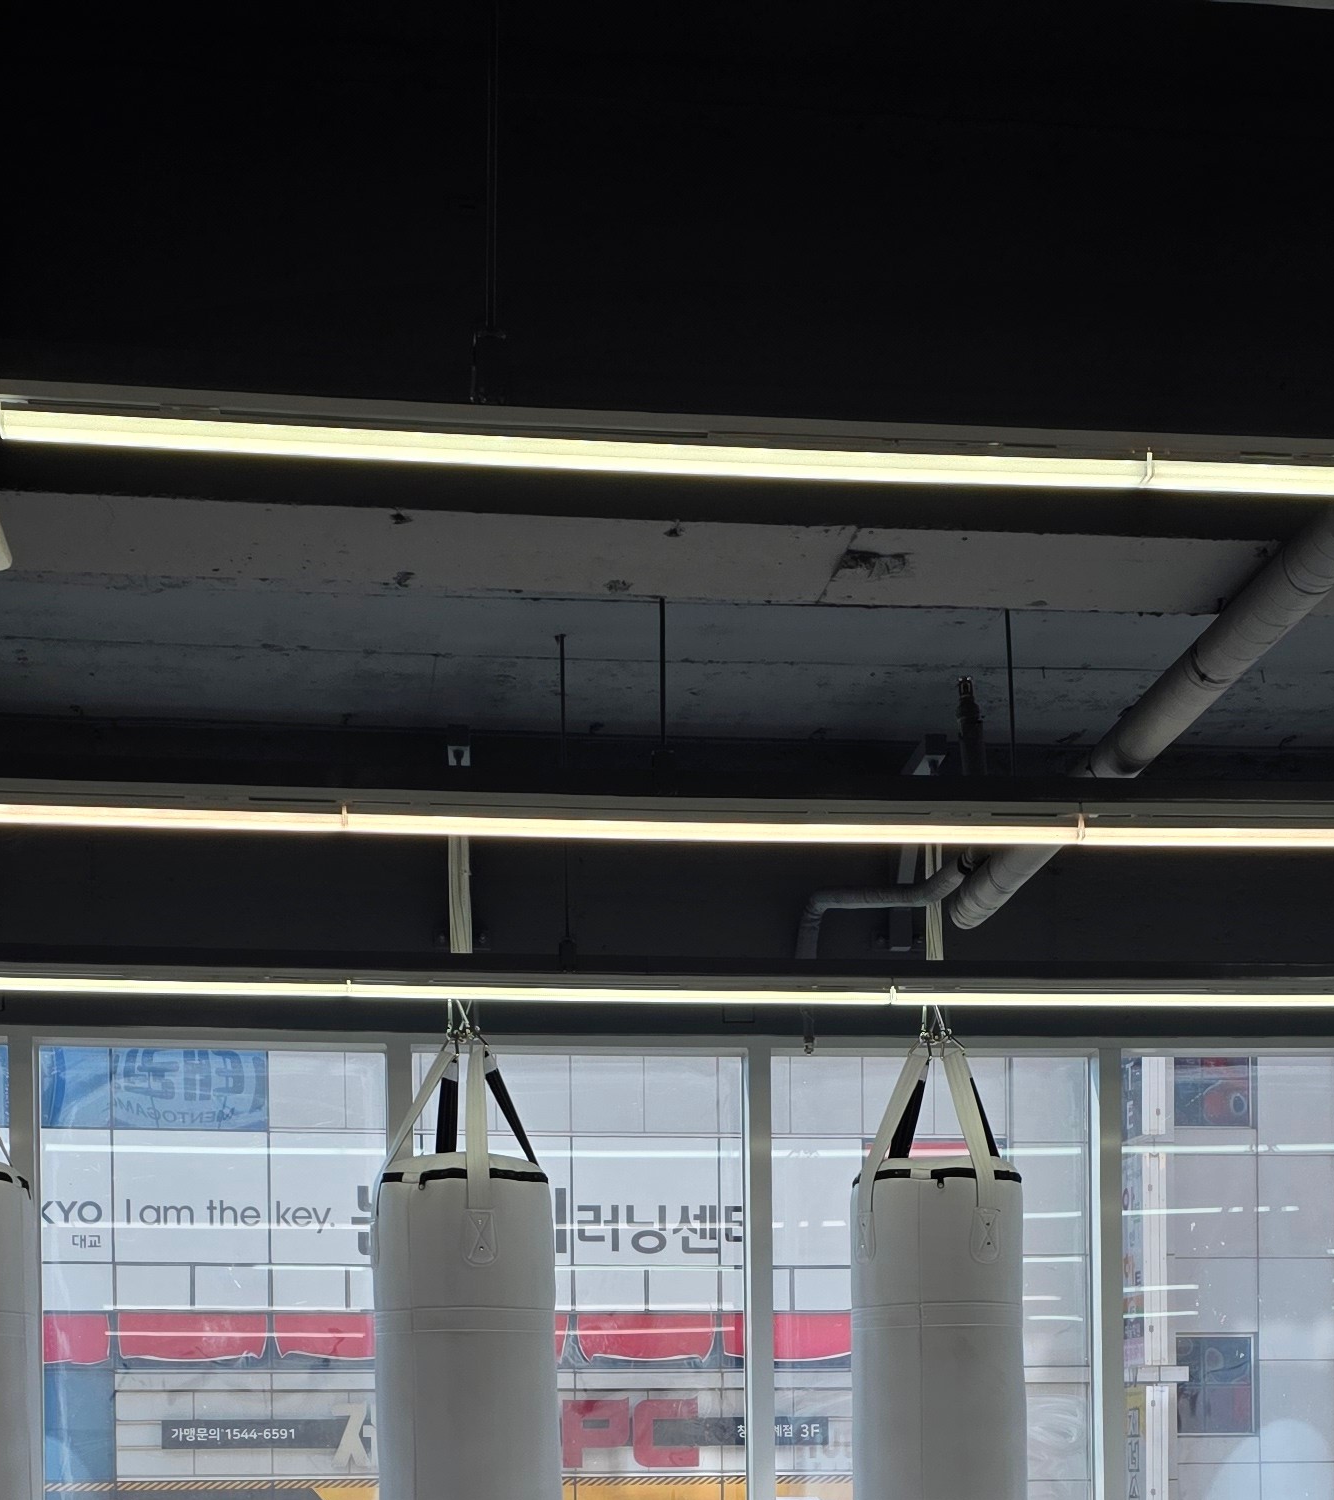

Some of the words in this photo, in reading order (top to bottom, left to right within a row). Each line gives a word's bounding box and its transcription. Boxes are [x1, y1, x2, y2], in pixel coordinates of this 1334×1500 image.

[125, 1199, 131, 1225] I
[139, 1204, 195, 1226] am
[207, 1199, 262, 1227] the
[275, 1200, 336, 1234] key.
[71, 1234, 102, 1249] 대교
[171, 1427, 220, 1441] 가맹문의
[225, 1428, 295, 1440] 1544-6591
[561, 1396, 700, 1468] PC
[800, 1423, 820, 1438] 3F
